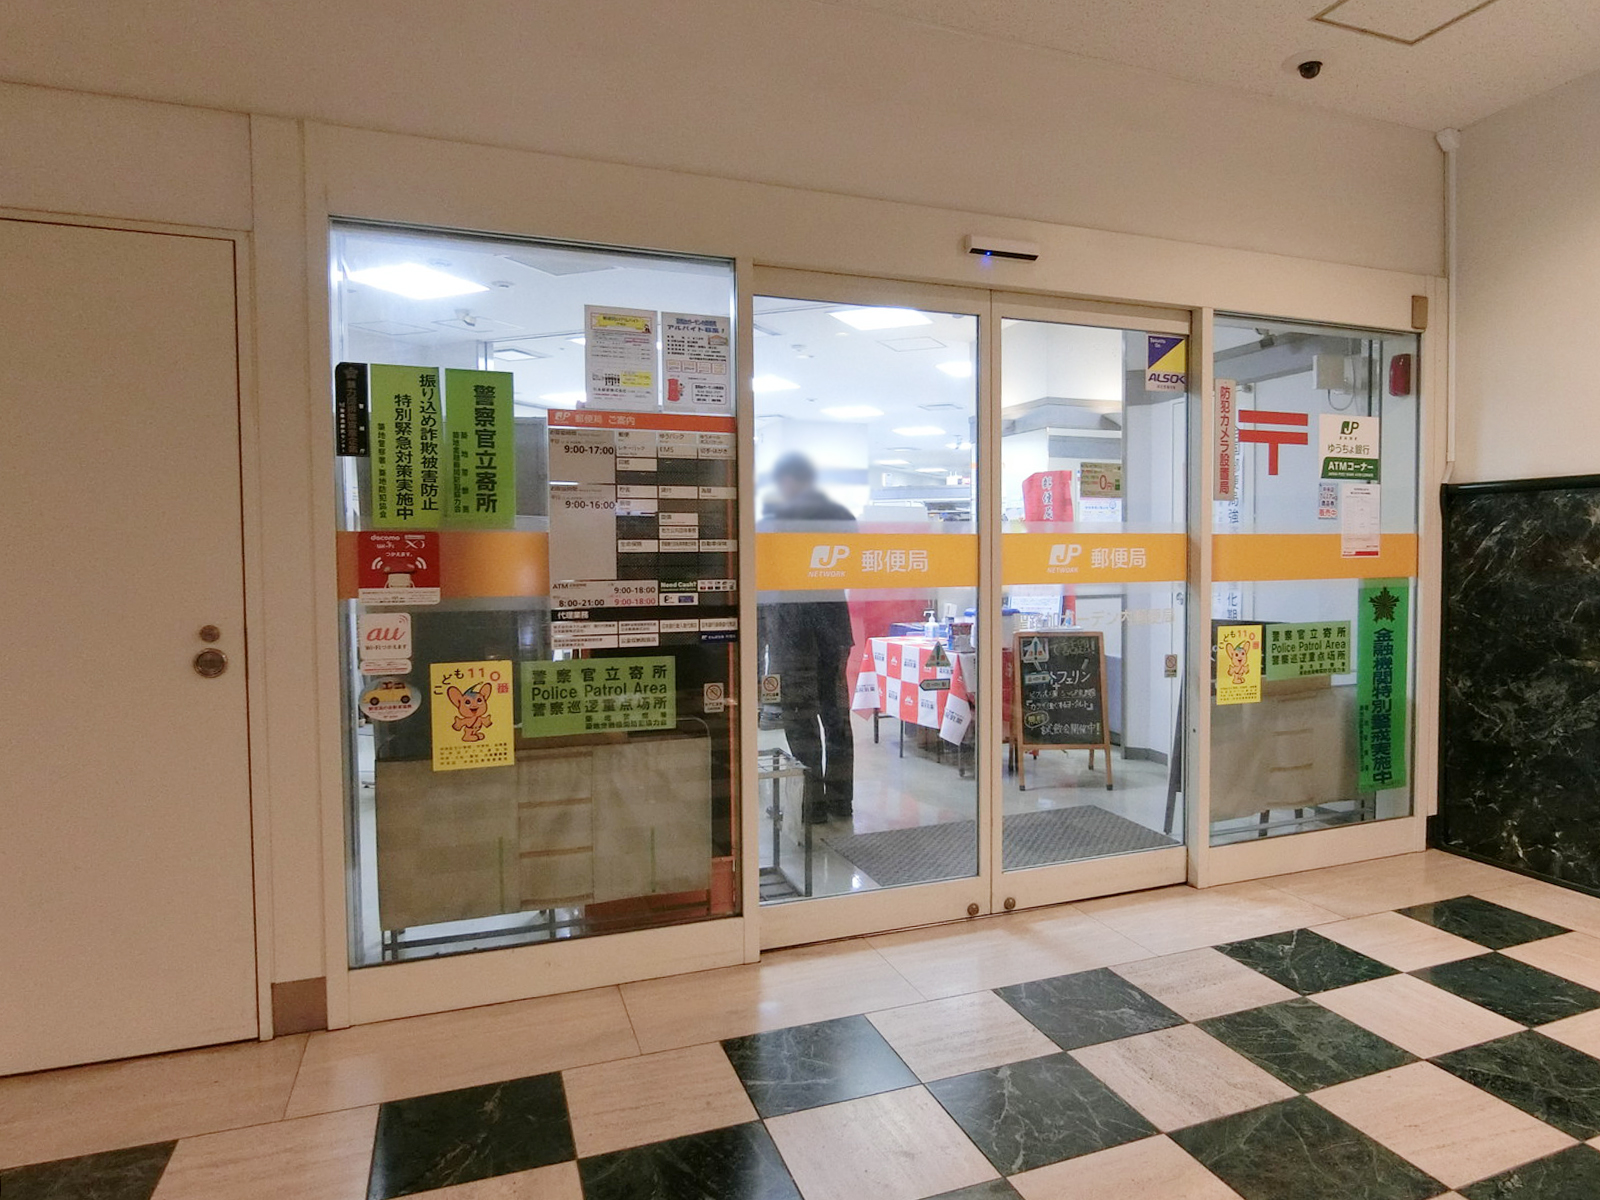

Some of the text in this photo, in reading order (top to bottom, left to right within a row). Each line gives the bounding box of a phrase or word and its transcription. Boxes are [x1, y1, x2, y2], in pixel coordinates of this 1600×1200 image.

[1148, 373, 1186, 384] ALSOK
[608, 415, 636, 426] ご案内
[1340, 420, 1359, 435] JP
[419, 374, 438, 511] 振り込め詐欺被害防止
[1219, 386, 1231, 494] 防犯カメラ設置局
[473, 384, 498, 513] 警察官立寄所
[564, 444, 614, 455] 9:00-17:00
[1328, 444, 1370, 455] ゆうちょ銀行
[394, 394, 414, 520] 特別緊急対策実施中
[1328, 461, 1374, 472] ATMコーナー
[565, 500, 616, 510] 9:00-16:00
[809, 544, 929, 572] JP 郵便局
[1048, 544, 1146, 569] JP 郵便局
[807, 570, 846, 578] NETWORK
[614, 586, 656, 594] 9:00-18:00
[558, 599, 605, 608] 8:00-21:00
[614, 598, 656, 606] 9:00-18:00
[558, 611, 590, 620] 代理業務
[366, 627, 406, 641] au
[1272, 626, 1346, 642] 警察官立寄所
[1272, 640, 1346, 654] Police Patrol Area
[532, 665, 668, 685] 警察官立寄所
[1049, 670, 1091, 684] トフェリン
[382, 681, 406, 690] エコ
[532, 682, 667, 701] Police Patrol Area
[1371, 628, 1394, 785] 金融機関特別警戒実施中
